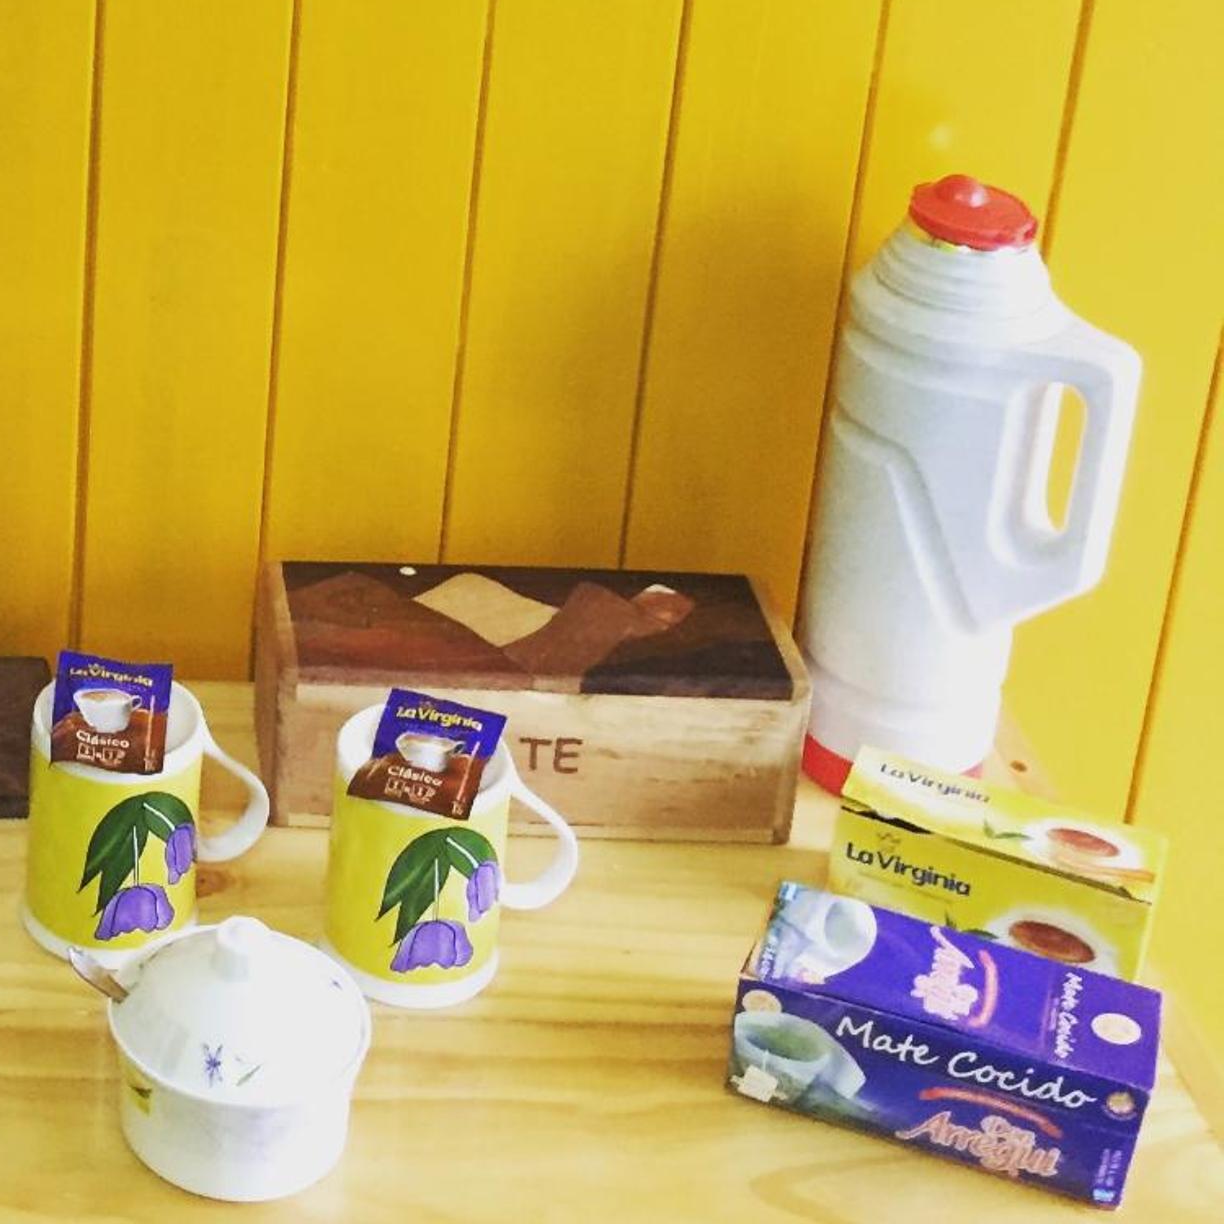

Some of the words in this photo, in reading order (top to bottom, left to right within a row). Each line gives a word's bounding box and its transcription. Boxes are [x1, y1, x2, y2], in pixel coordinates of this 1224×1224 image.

[519, 737, 584, 775] TE
[835, 1016, 939, 1065] Mate
[947, 1052, 1097, 1108] Cocido
